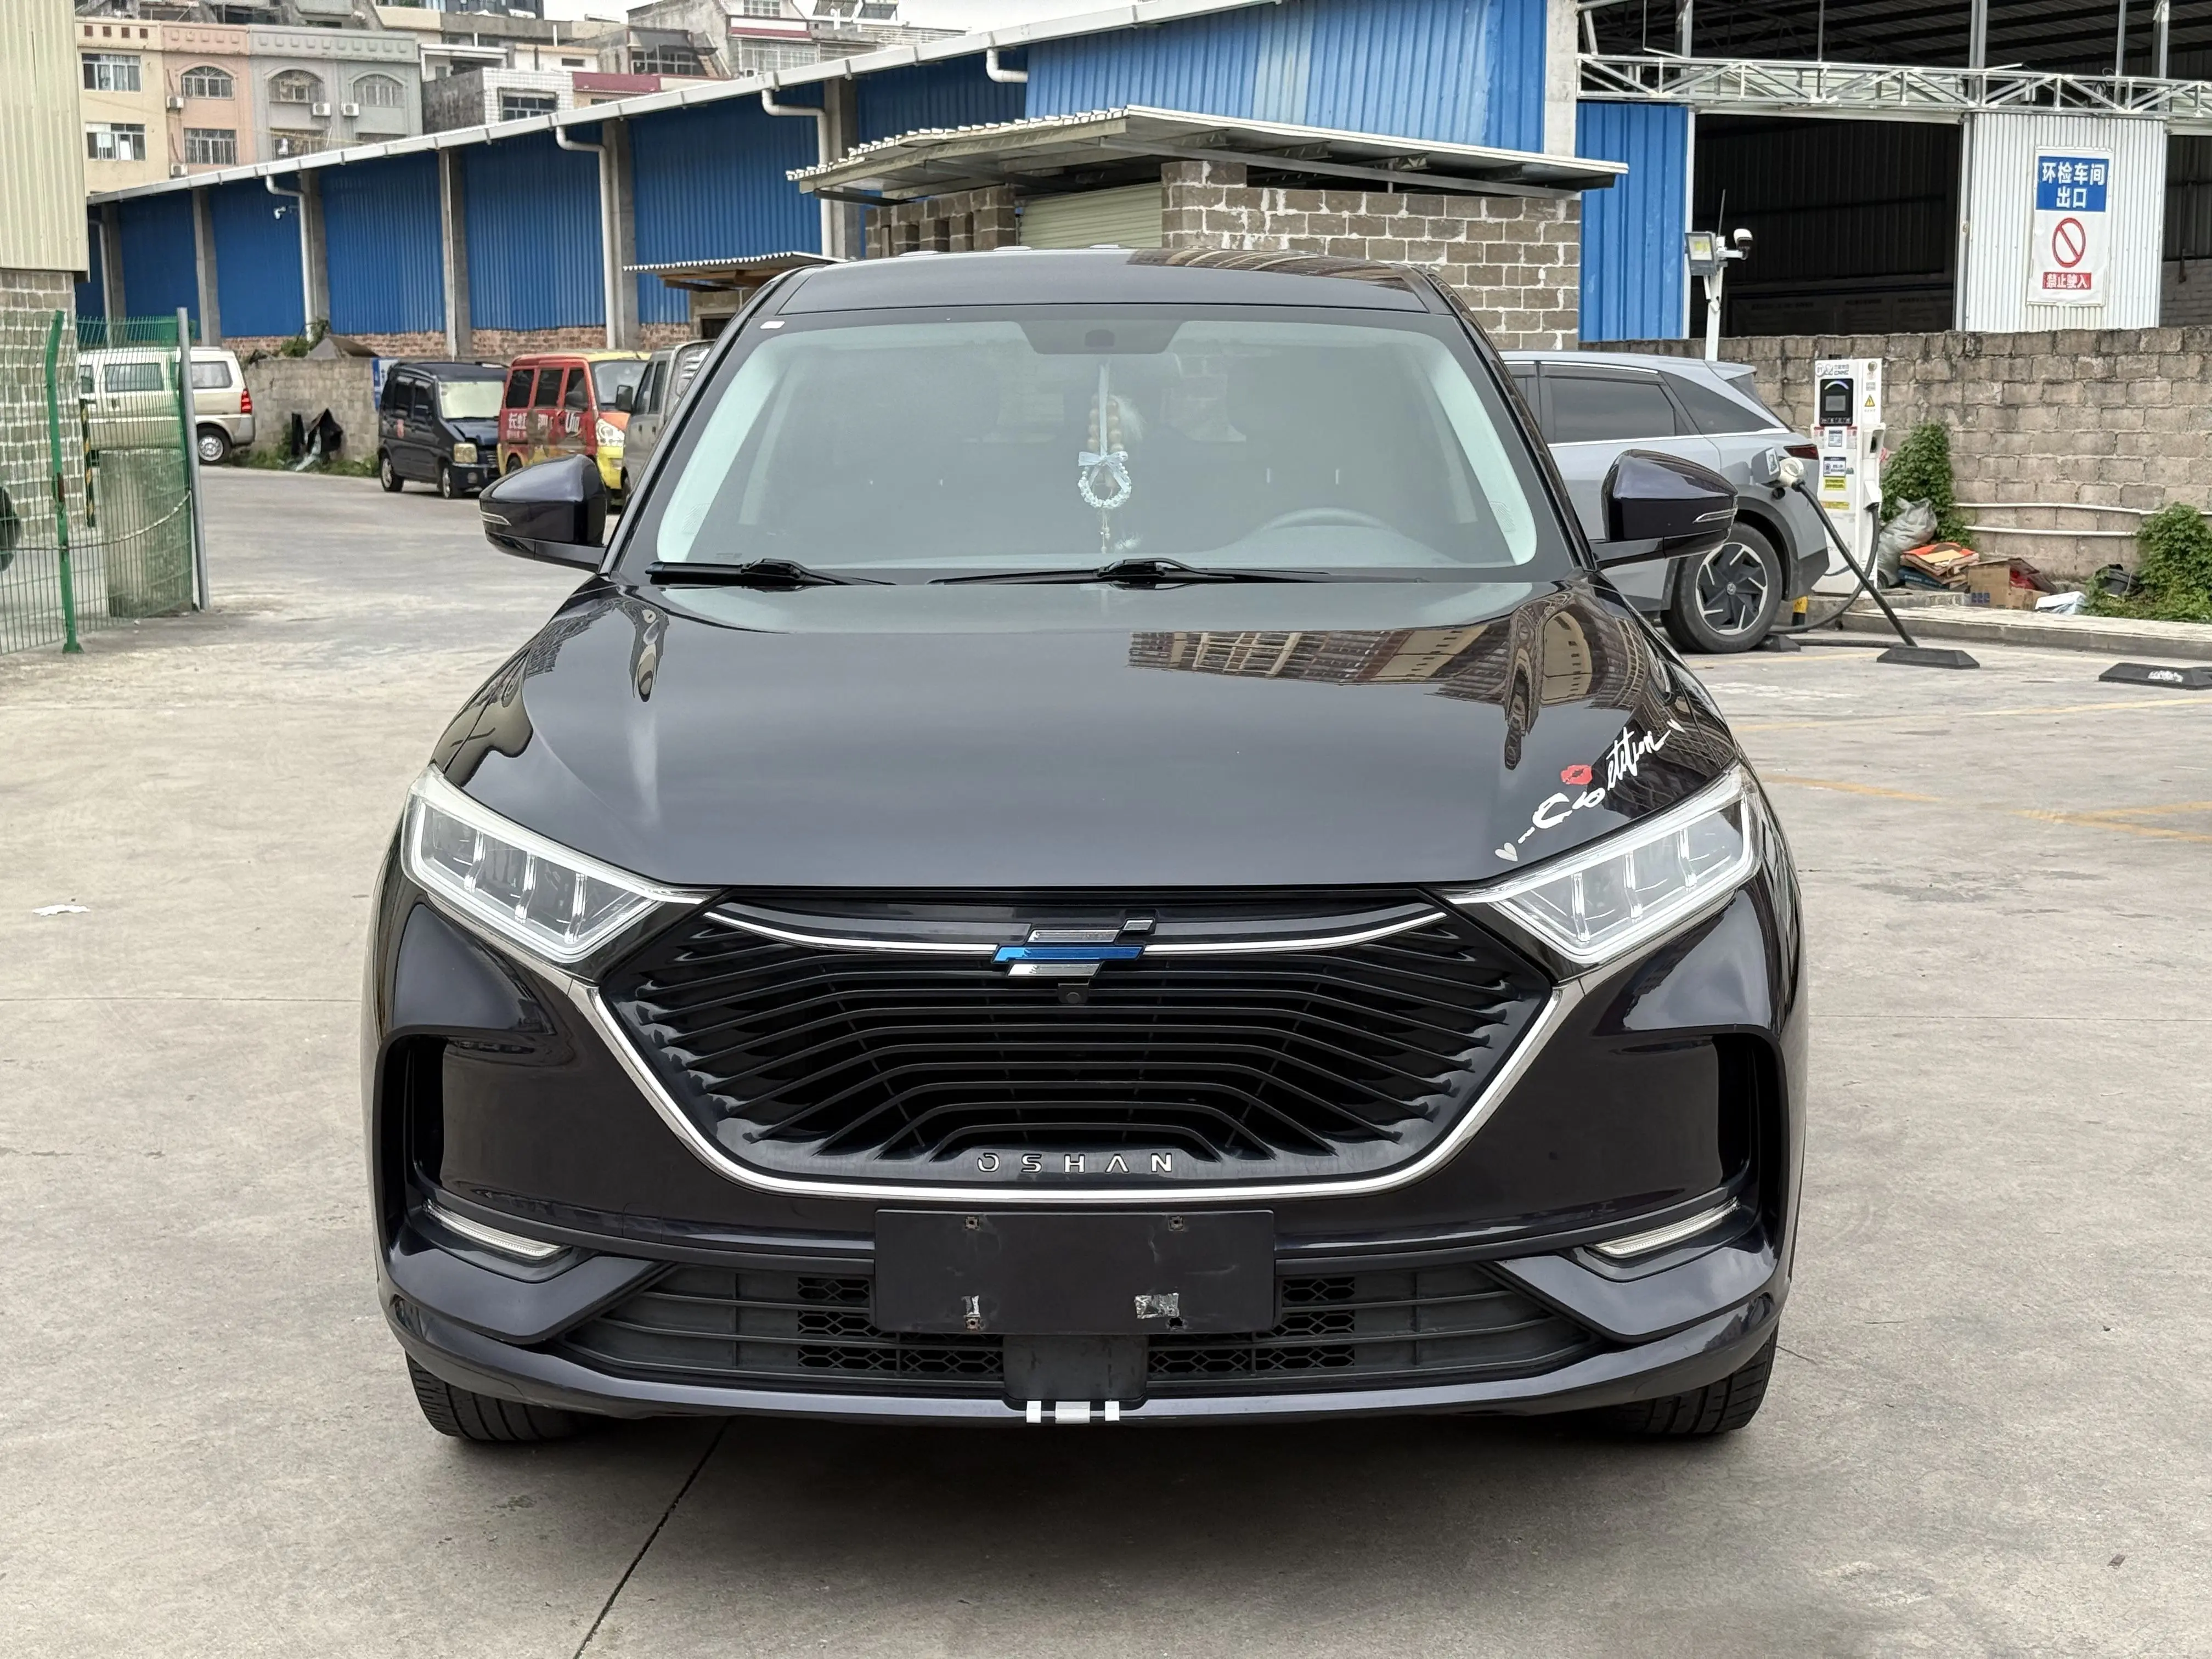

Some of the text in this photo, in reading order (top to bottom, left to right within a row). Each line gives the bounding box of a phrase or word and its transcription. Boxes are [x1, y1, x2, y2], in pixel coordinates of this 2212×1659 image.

[2042, 162, 2106, 185] 环检车间
[2056, 186, 2087, 208] 出口
[2046, 274, 2088, 289] 禁止驶入
[977, 1153, 1173, 1173] OSHAN
